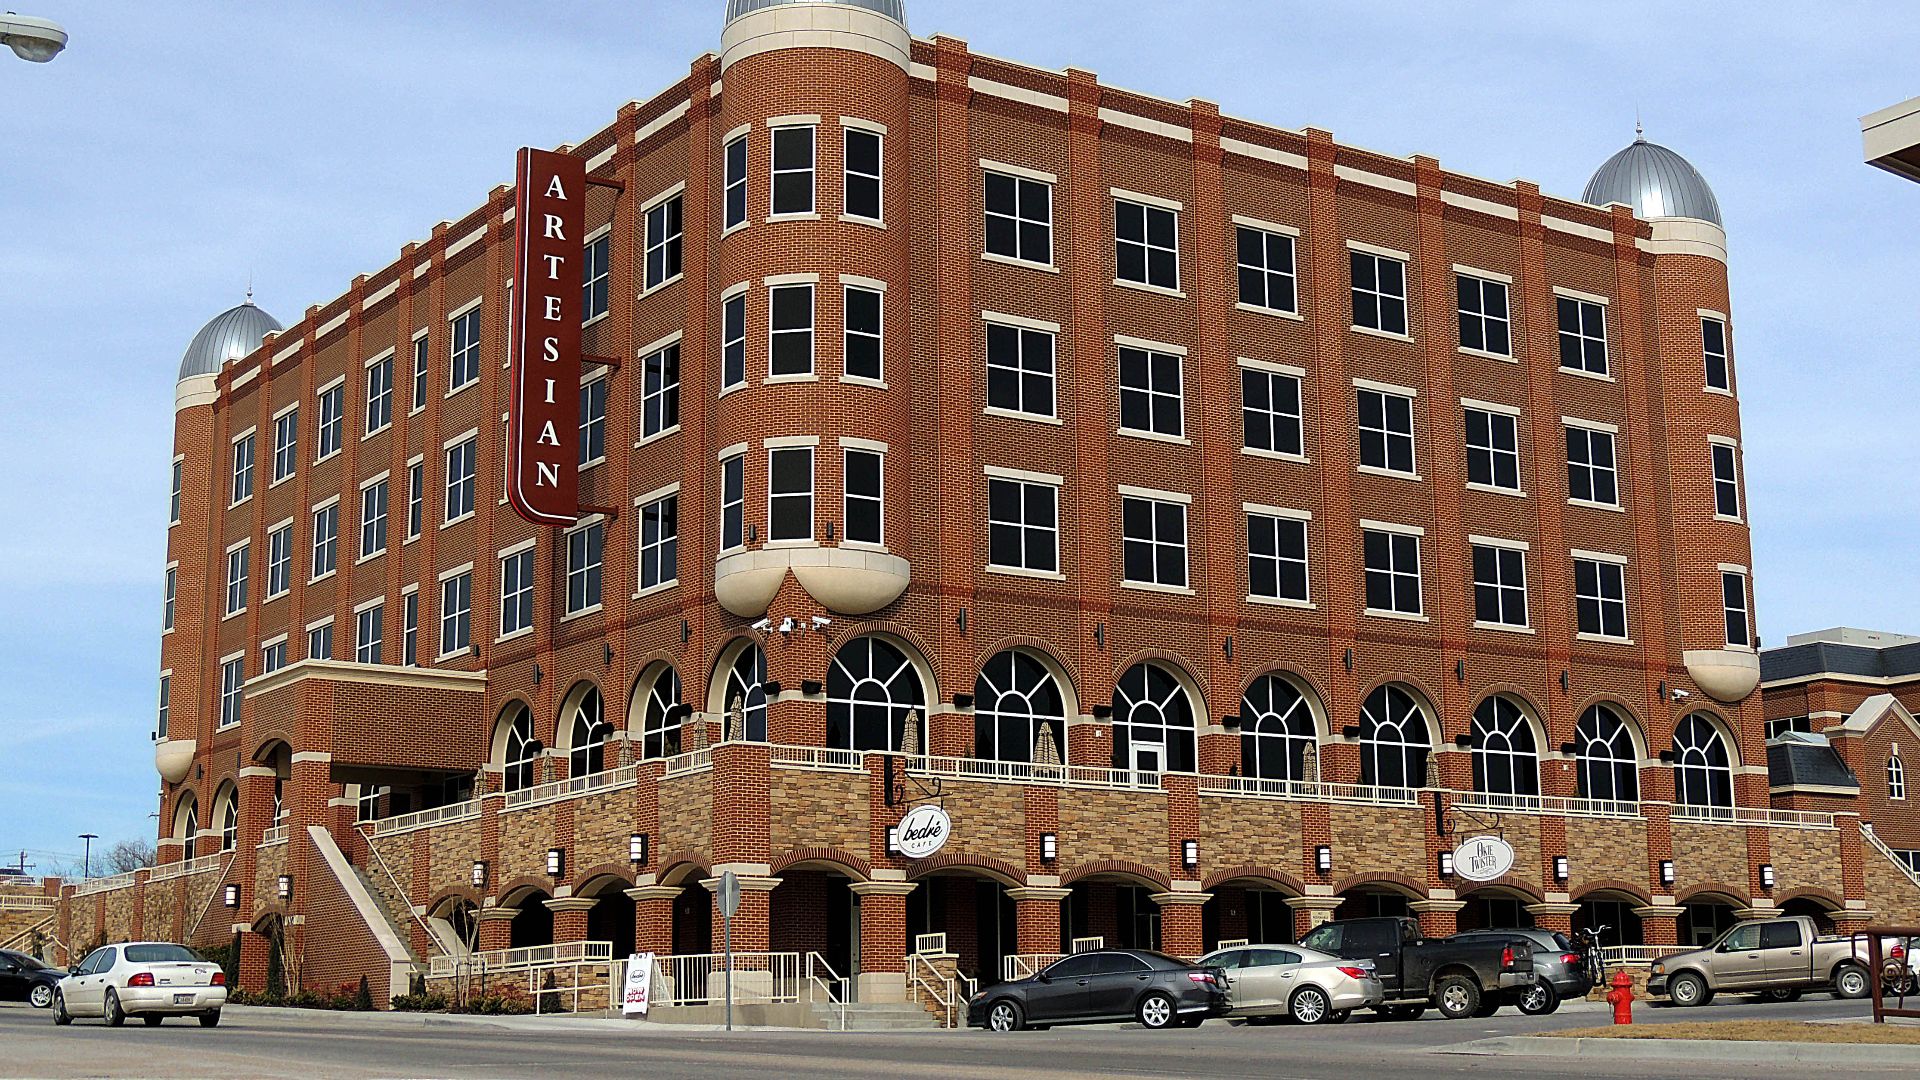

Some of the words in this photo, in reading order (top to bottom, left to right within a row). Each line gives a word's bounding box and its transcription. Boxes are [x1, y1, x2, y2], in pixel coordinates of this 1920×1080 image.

[535, 174, 568, 488] ARTESIAN
[903, 815, 942, 841] bedré
[911, 841, 932, 849] CAFE
[628, 986, 645, 995] NOW
[626, 994, 646, 1003] OPEN
